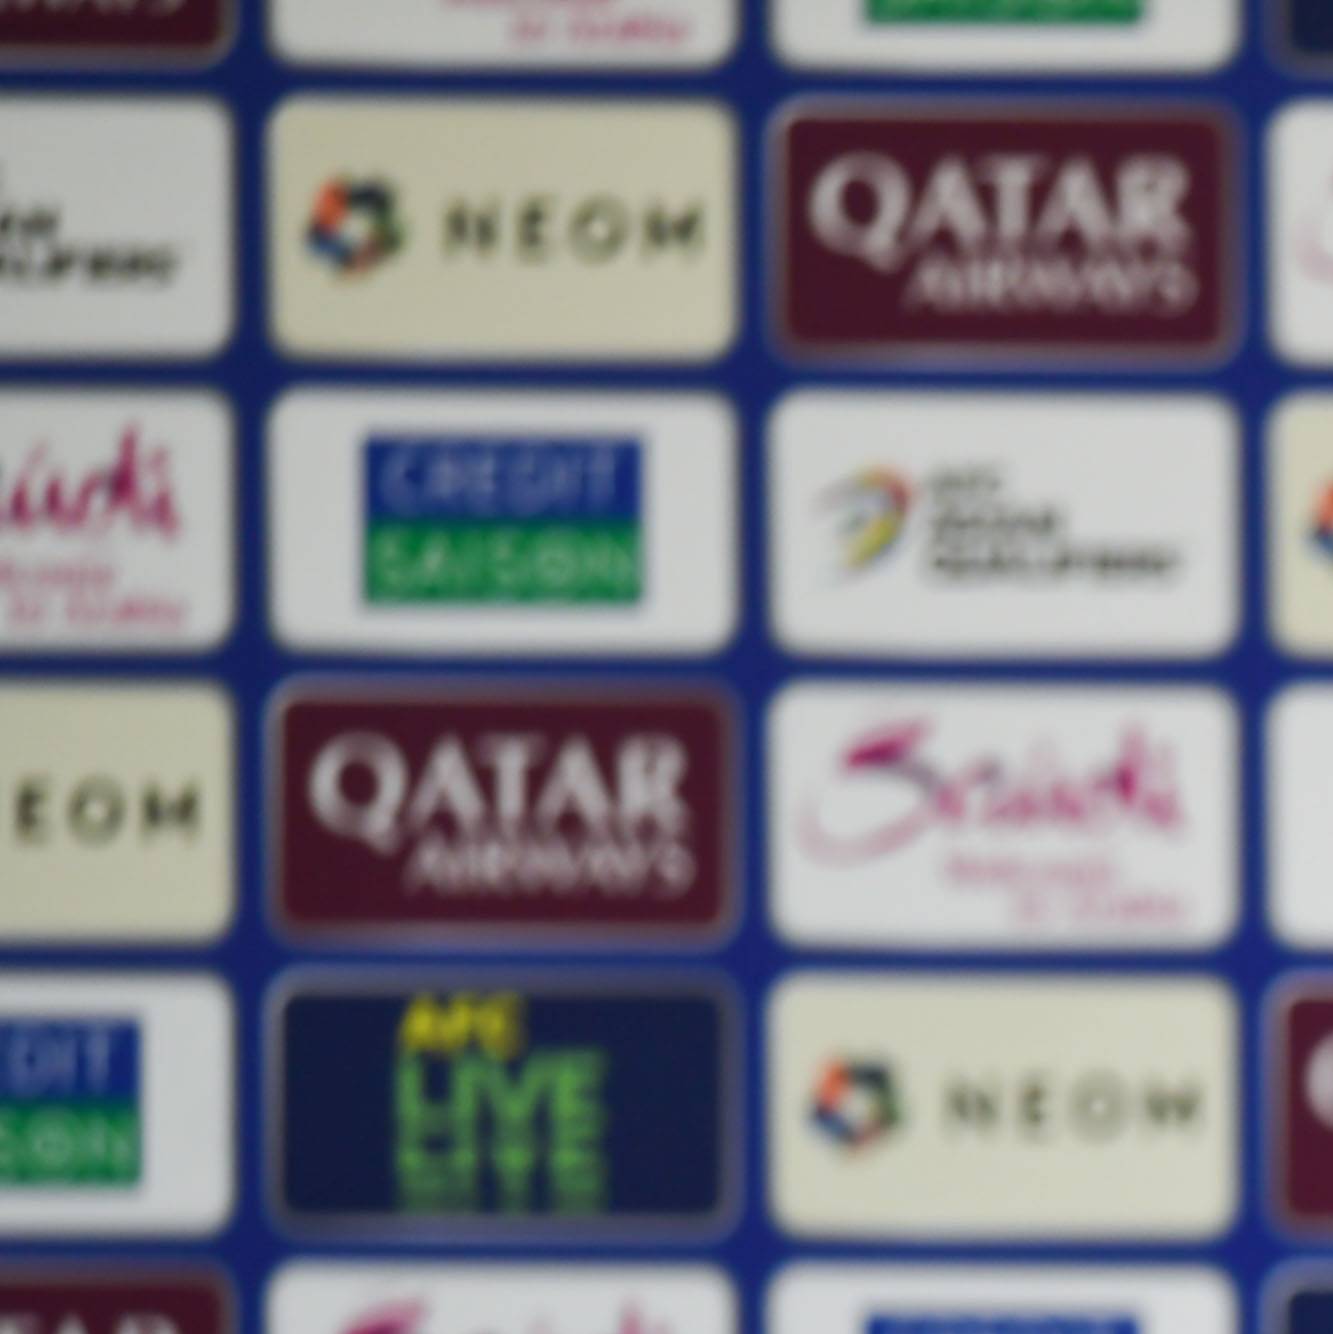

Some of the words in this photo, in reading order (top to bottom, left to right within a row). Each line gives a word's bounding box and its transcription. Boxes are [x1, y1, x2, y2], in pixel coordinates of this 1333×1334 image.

[442, 195, 706, 264] NEOM
[808, 152, 1192, 272] QATAR
[905, 242, 1200, 312] AIRWAYS
[383, 455, 620, 522] CREDIT
[370, 532, 642, 598] SAISON
[16, 783, 197, 845] EOM
[308, 732, 692, 855] QATAR
[408, 838, 695, 896] AIRWAYS
[10, 1030, 114, 1095] DIT
[942, 1072, 1202, 1145] NEOM
